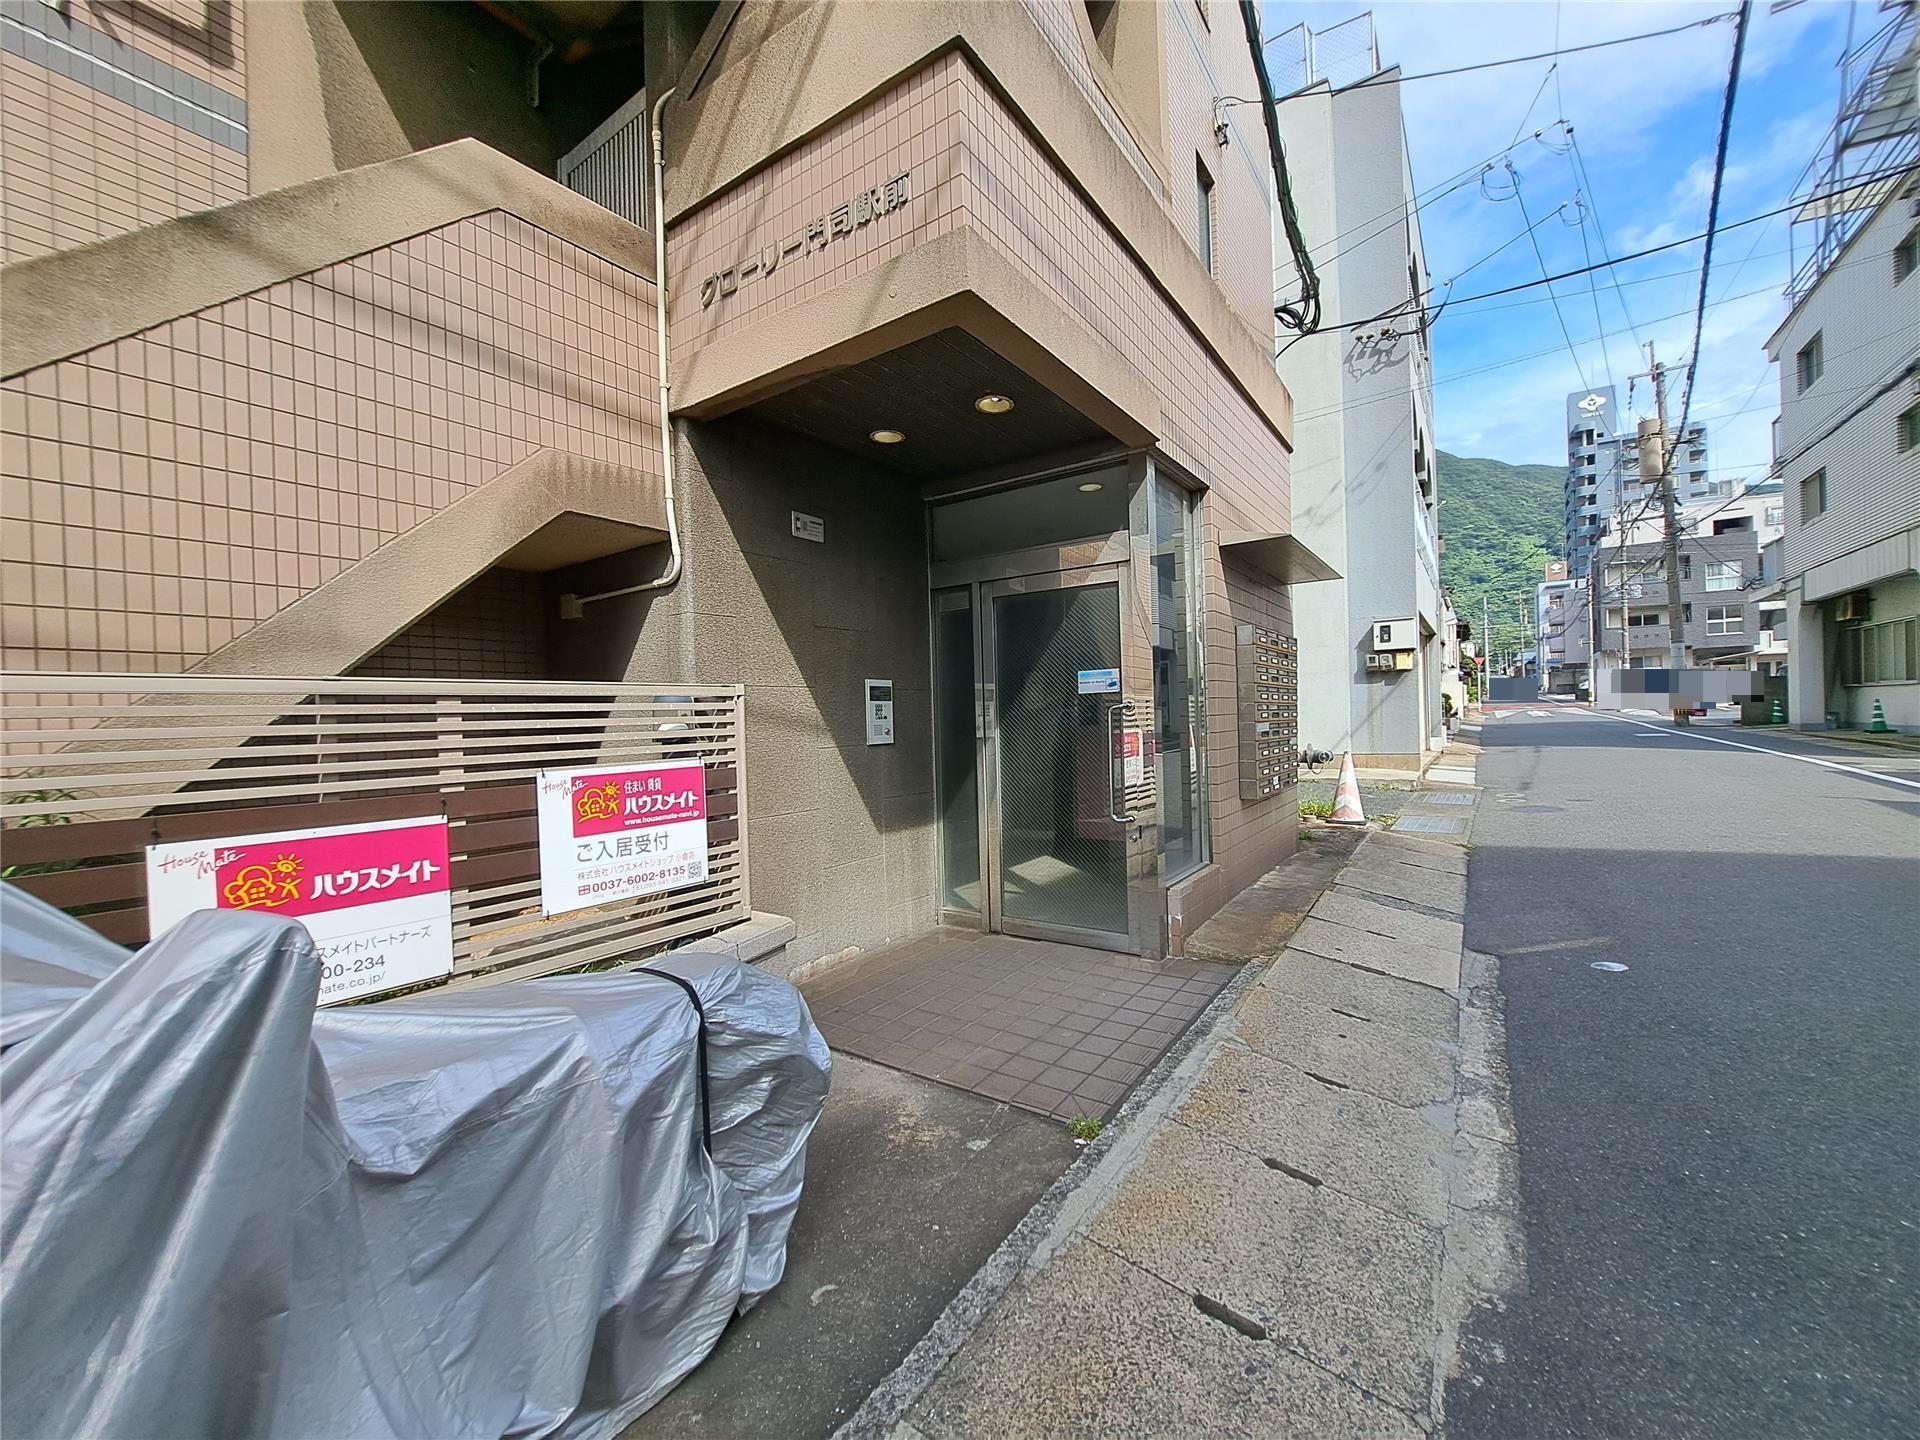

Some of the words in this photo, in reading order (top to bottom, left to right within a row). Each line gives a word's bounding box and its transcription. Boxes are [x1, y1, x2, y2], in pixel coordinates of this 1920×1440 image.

[701, 170, 910, 307] グローリー門司駅前
[542, 779, 568, 795] House
[562, 779, 588, 800] Mate
[624, 780, 646, 794] 住まい
[623, 790, 699, 816] ハウスメイト
[624, 809, 700, 826] www.housemate-navi.jp
[576, 831, 669, 863] ご入居受付
[157, 850, 209, 875] House
[197, 850, 247, 880] Mate
[577, 867, 608, 881] 株式会社
[610, 853, 673, 875] ハウスメイトショップ
[310, 860, 441, 900] ハウスメイト
[592, 865, 686, 893] 0037-6002-8135
